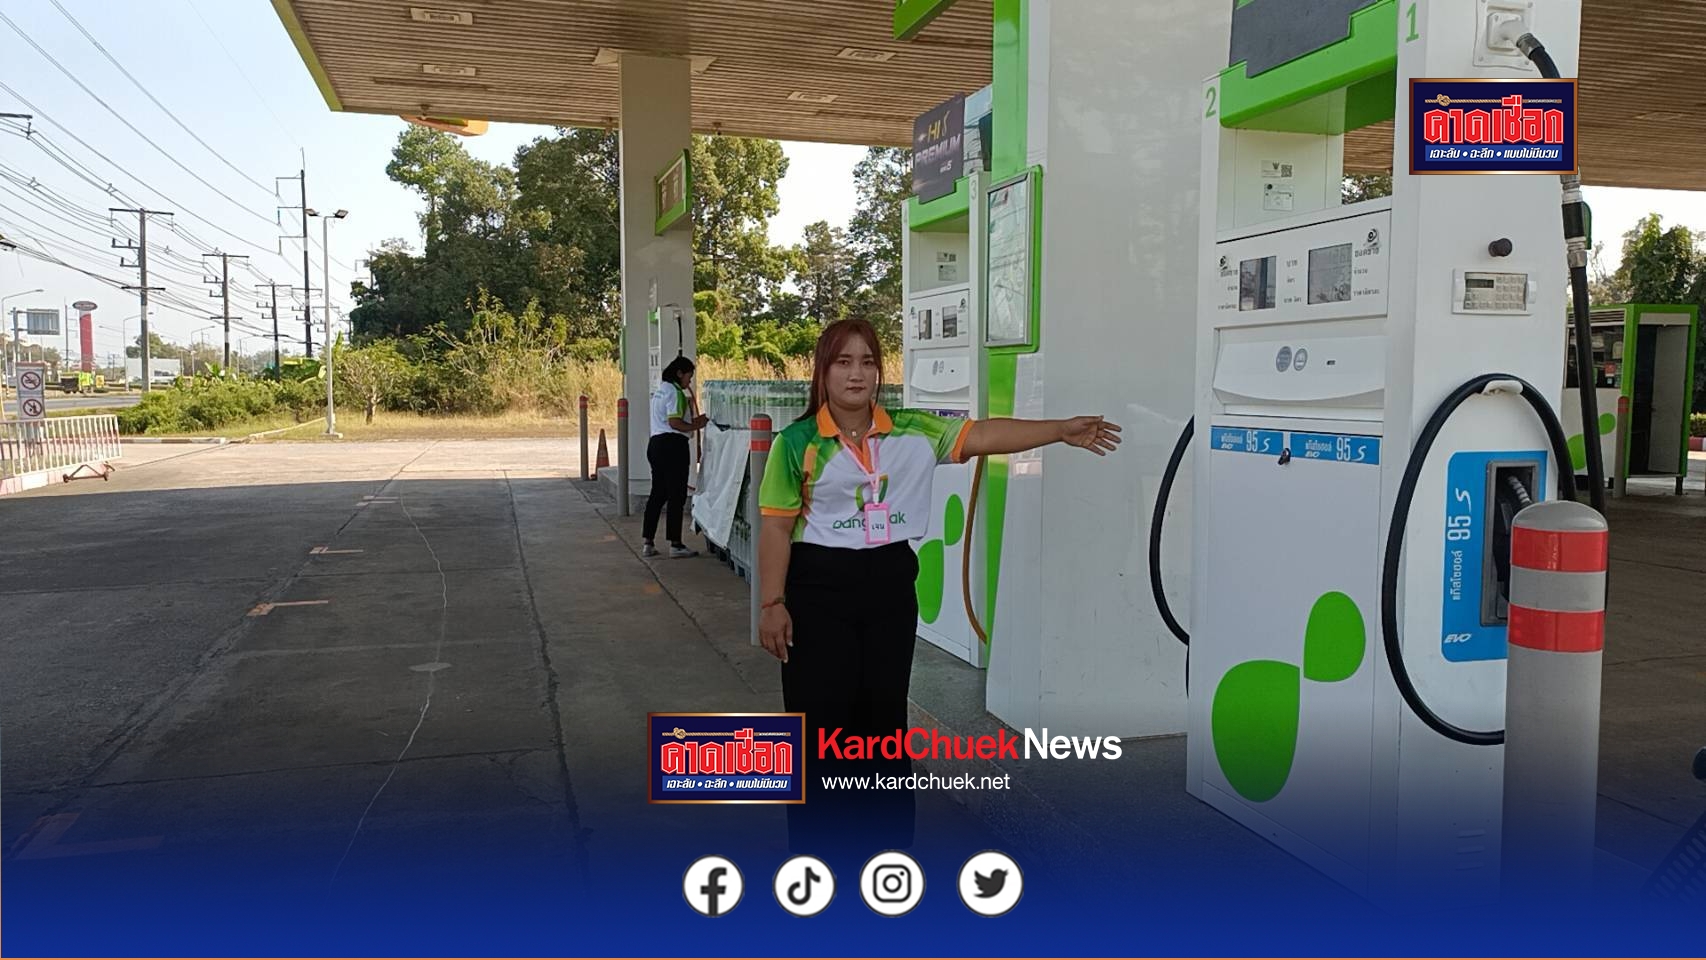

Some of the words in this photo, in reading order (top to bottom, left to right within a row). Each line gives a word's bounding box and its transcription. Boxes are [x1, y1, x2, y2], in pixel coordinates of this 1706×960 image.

[1406, 2, 1419, 43] 1
[1205, 86, 1217, 118] 2
[915, 133, 961, 163] PREMIUM
[1246, 430, 1258, 452] 95
[1336, 436, 1351, 462] 95
[1447, 515, 1472, 541] 95
[1444, 633, 1472, 644] EVO
